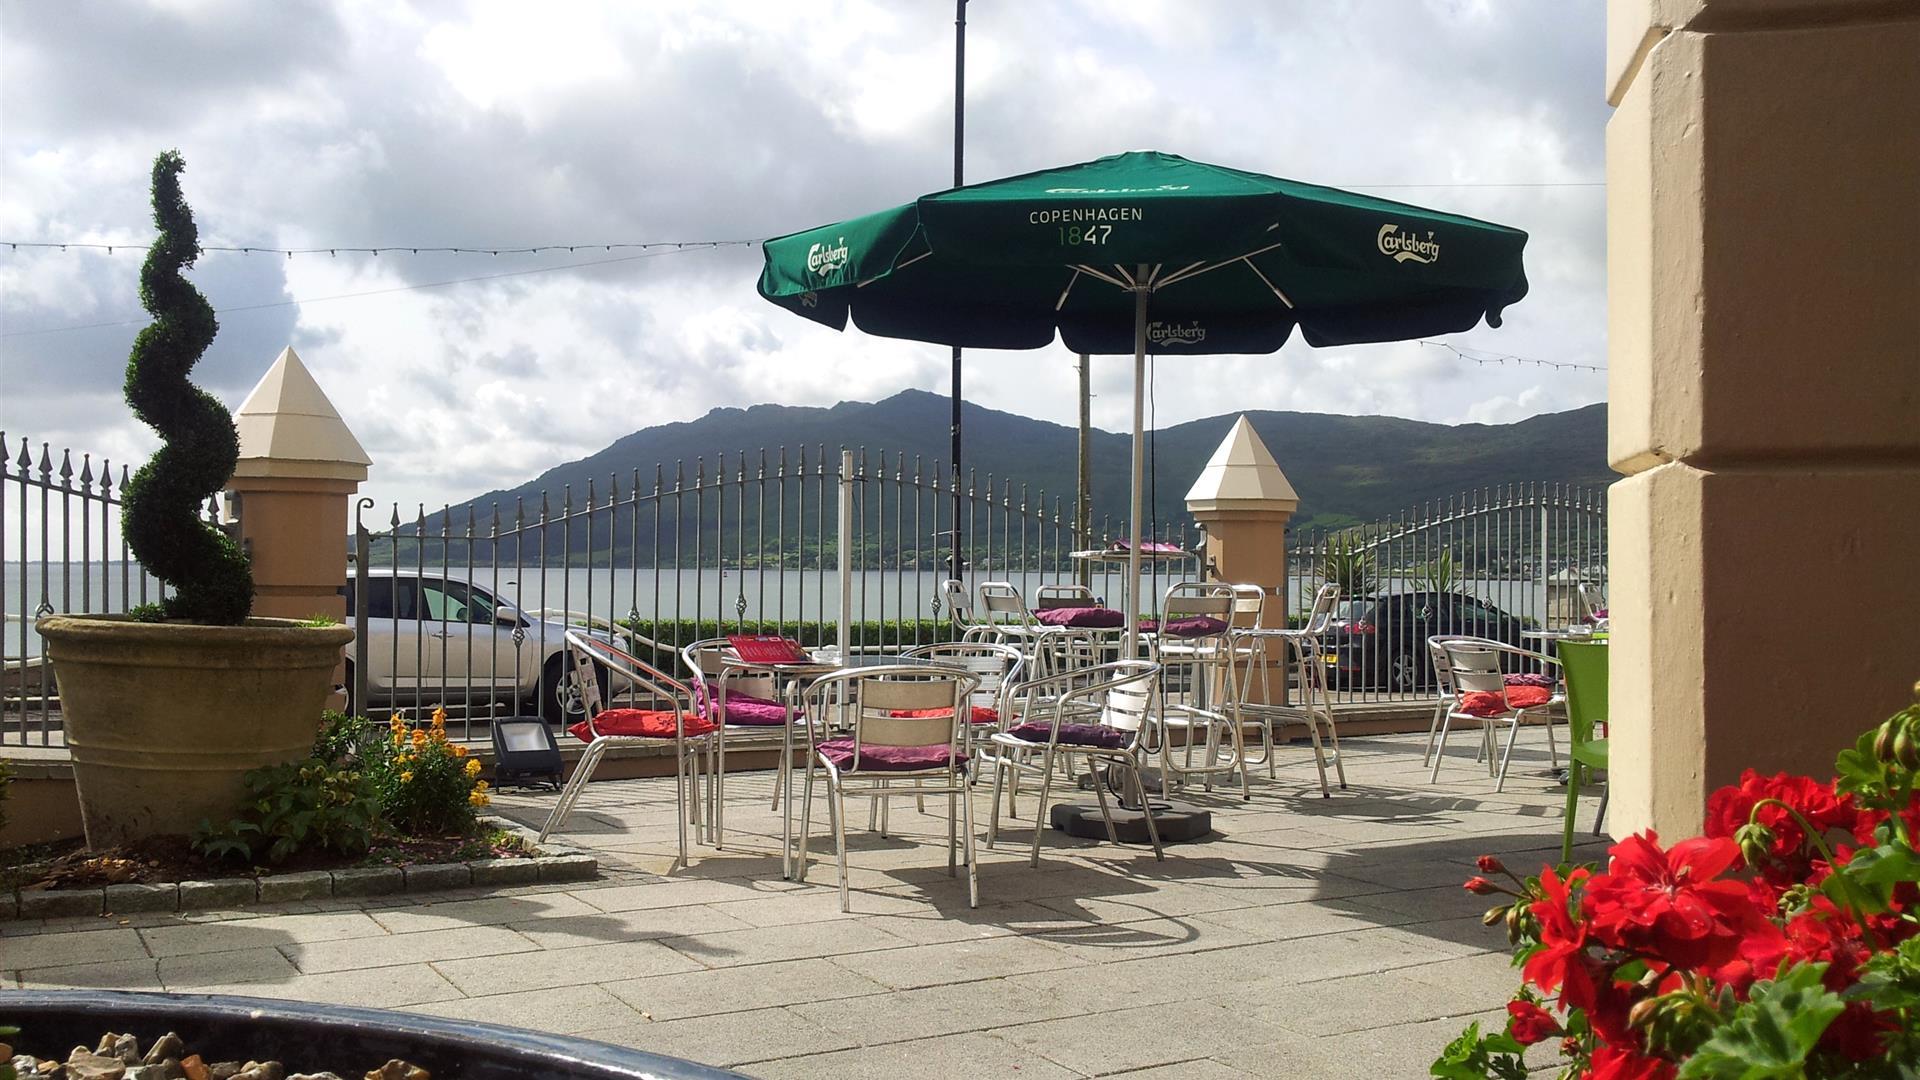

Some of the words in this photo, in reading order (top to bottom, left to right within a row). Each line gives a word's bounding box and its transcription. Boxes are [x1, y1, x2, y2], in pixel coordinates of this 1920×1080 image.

[1029, 207, 1143, 224] COPENHAGEN
[1058, 225, 1112, 246] 1847
[1377, 224, 1440, 263] Carlsberg
[808, 236, 848, 277] Carlsberg
[1145, 321, 1206, 347] Carlsberg
